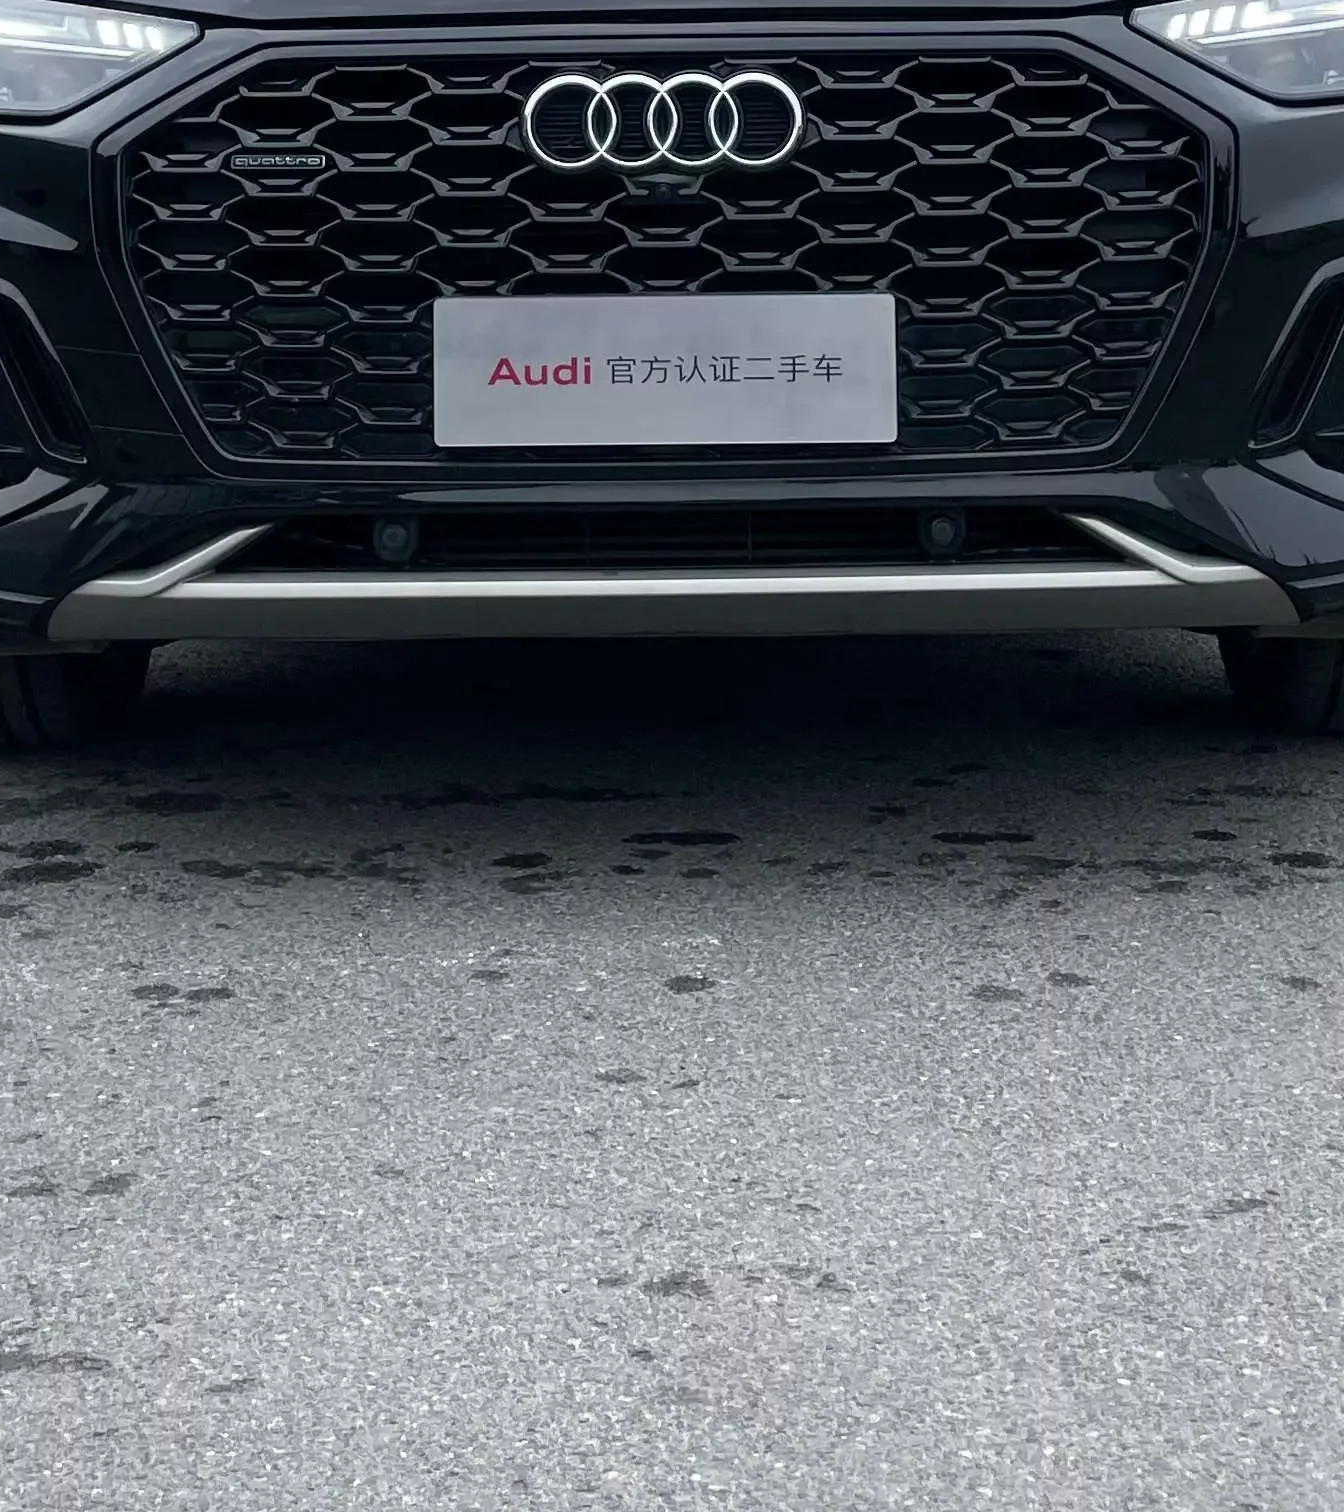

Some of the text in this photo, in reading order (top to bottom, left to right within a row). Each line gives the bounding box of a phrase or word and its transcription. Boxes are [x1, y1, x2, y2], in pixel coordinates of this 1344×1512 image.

[235, 155, 321, 167] quattro
[487, 353, 844, 387] Audi 官方认证二手车
